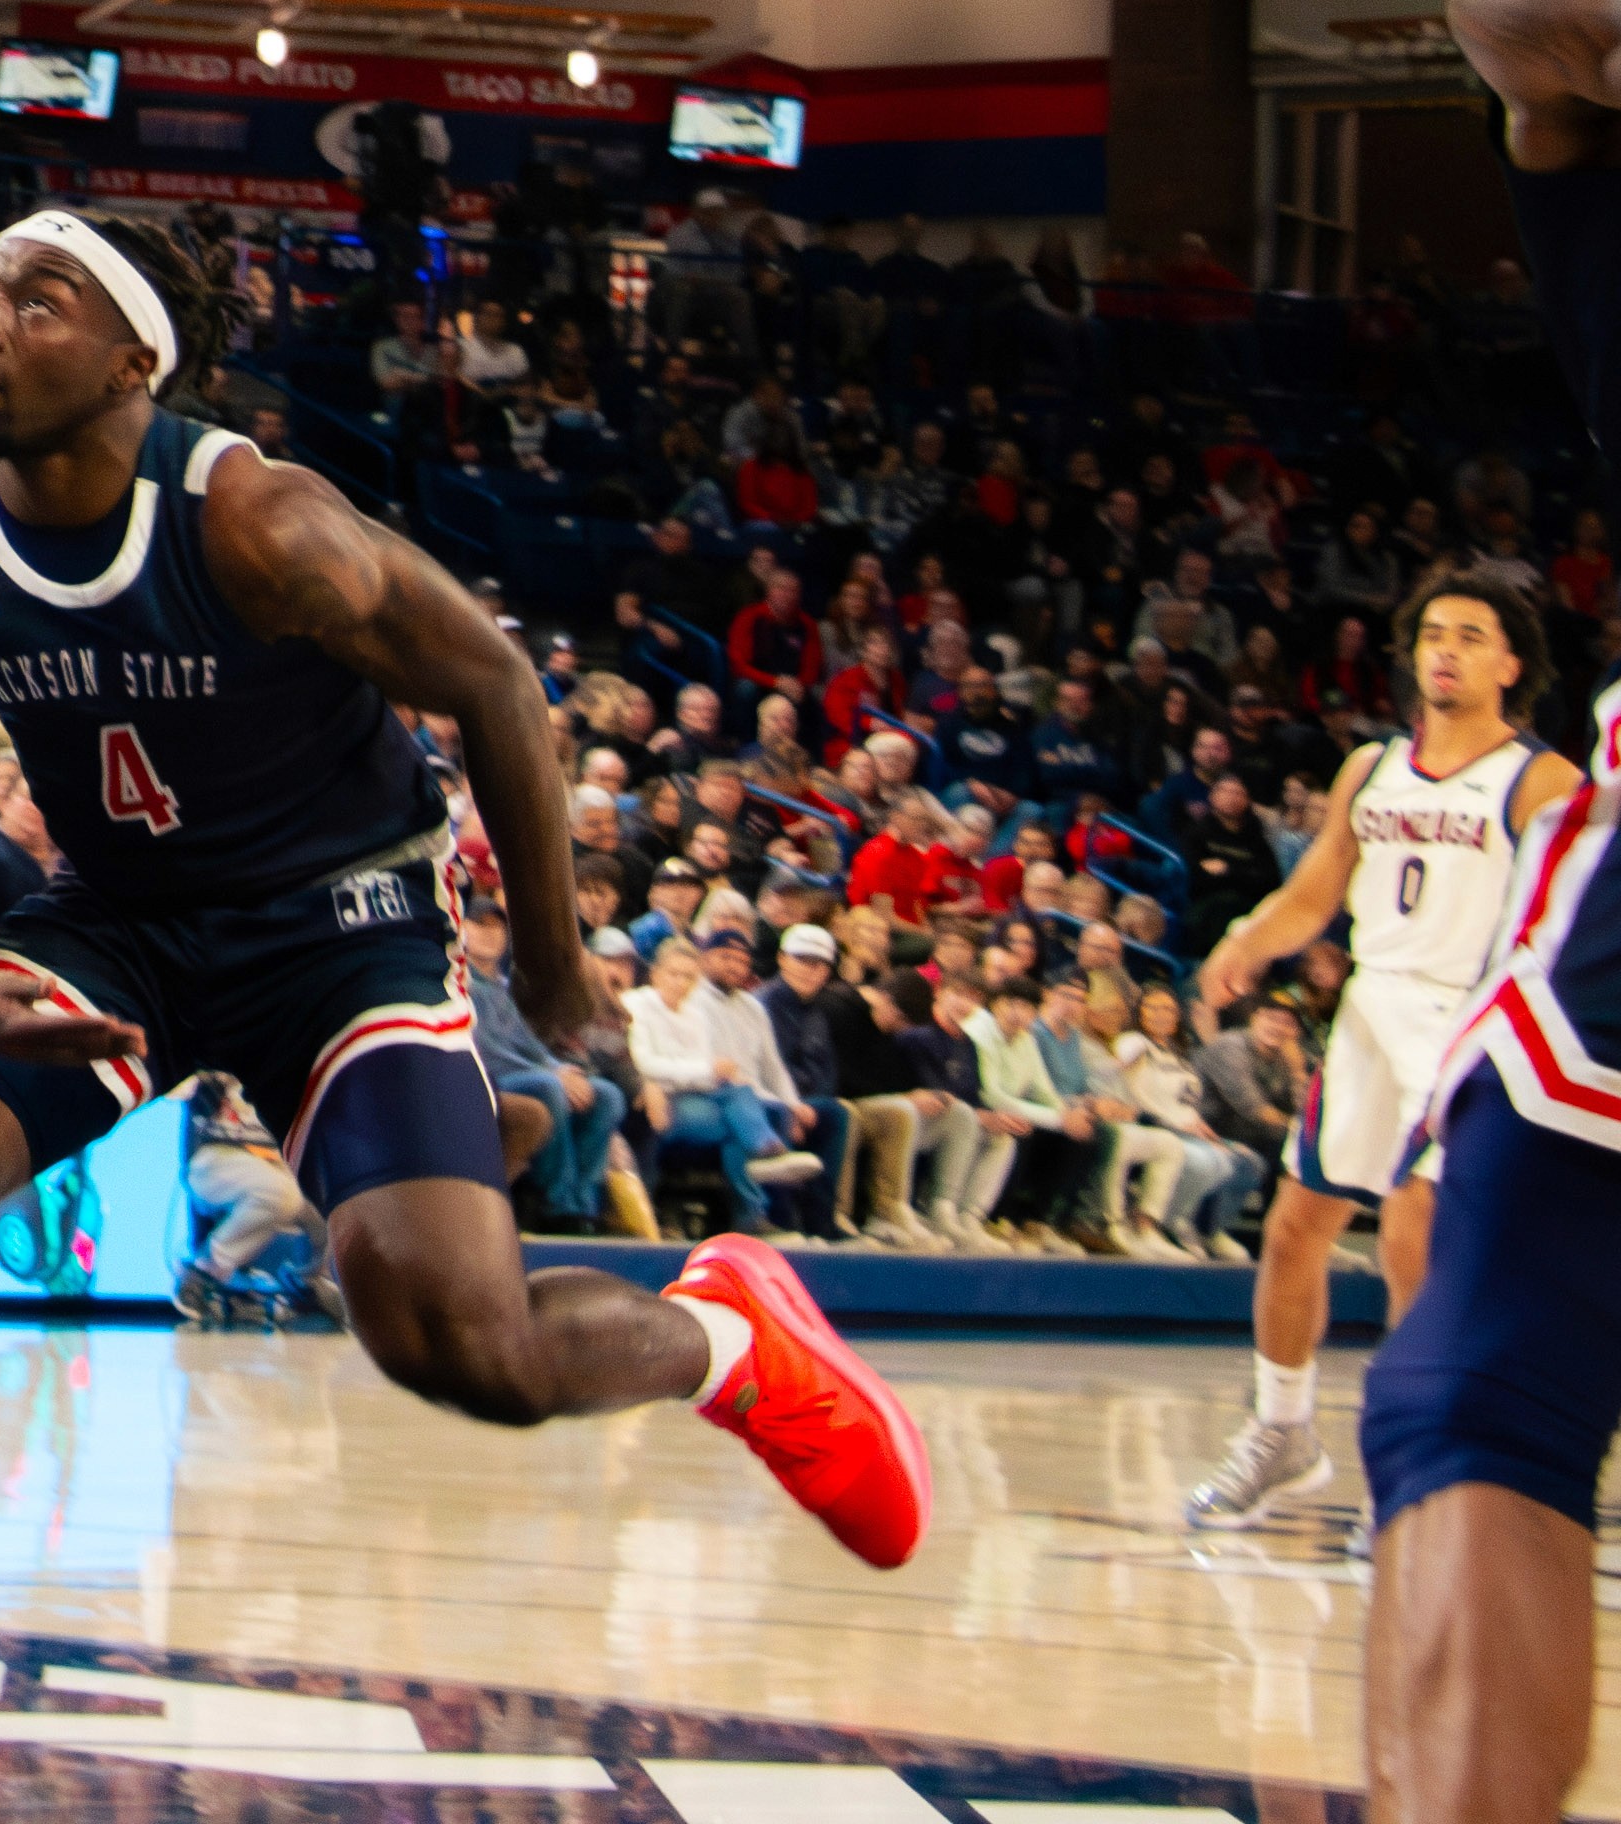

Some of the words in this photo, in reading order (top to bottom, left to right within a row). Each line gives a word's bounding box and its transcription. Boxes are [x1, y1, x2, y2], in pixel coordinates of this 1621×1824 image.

[443, 70, 526, 103] TACO
[123, 651, 217, 699] STATE
[99, 723, 183, 837] 4
[1397, 856, 1425, 916] 0
